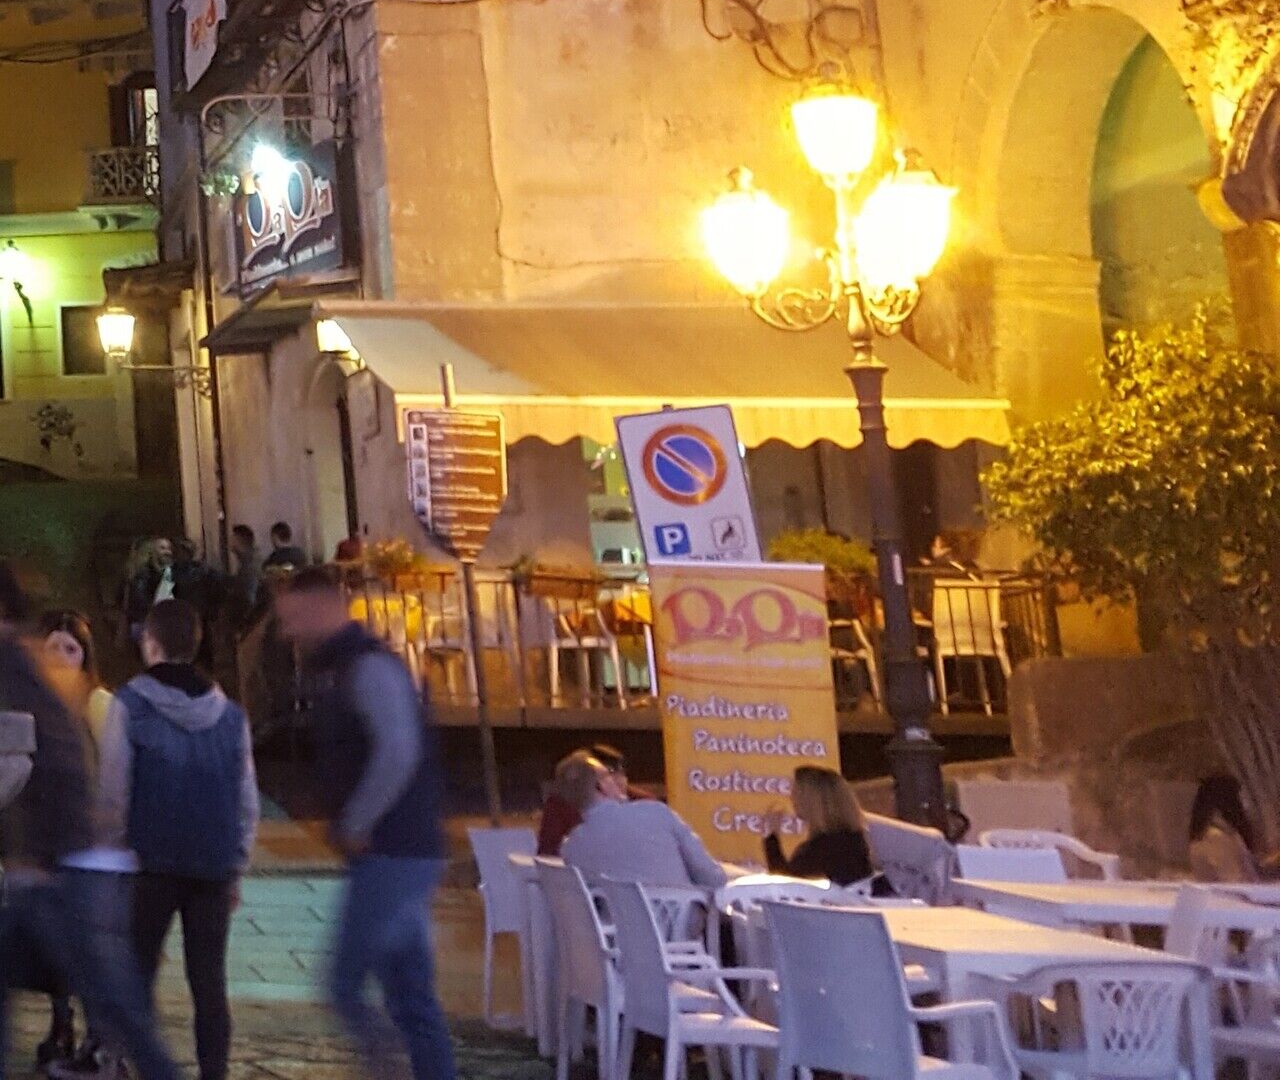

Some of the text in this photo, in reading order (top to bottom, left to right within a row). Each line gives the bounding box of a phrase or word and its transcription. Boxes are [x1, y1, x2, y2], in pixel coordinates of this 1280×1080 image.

[662, 527, 684, 554] P
[666, 695, 788, 720] Piadineria
[694, 728, 826, 757] Paninoteca
[689, 769, 791, 794] Rosticce
